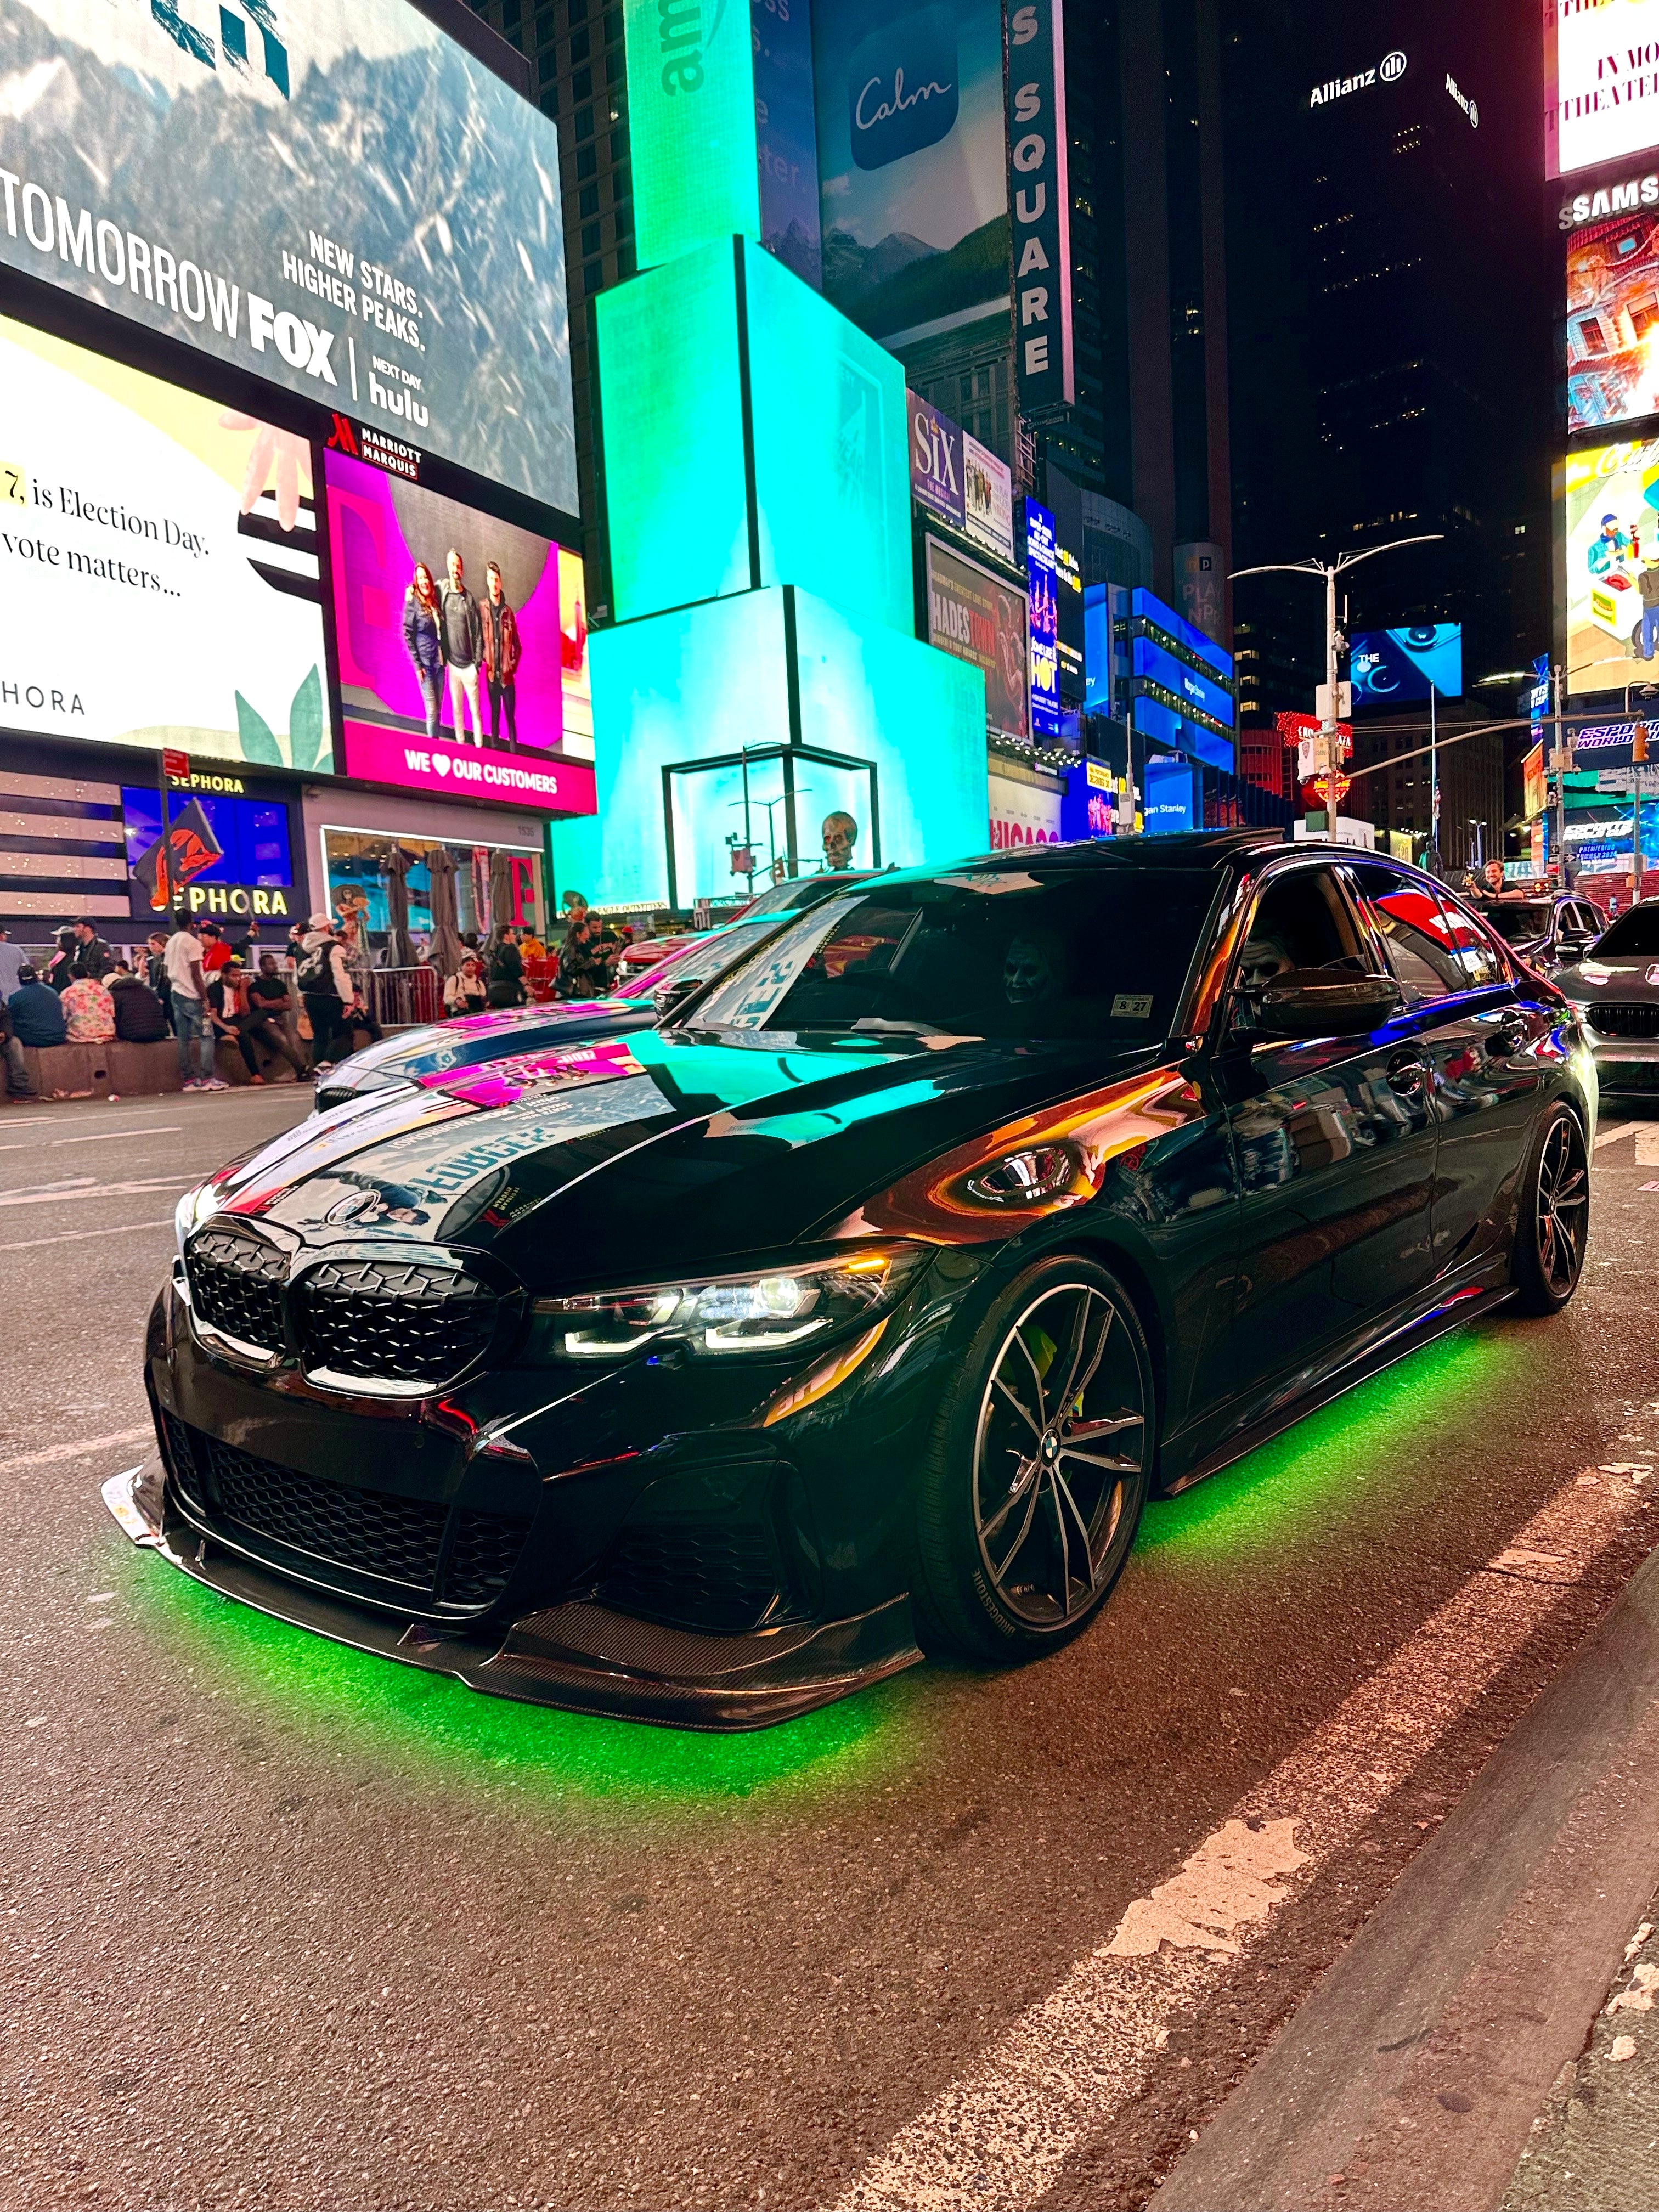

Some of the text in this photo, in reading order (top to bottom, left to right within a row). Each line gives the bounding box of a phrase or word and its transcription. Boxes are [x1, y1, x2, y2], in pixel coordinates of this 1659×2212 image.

[1310, 67, 1376, 108] Allianz
[1598, 54, 1619, 80] IN
[856, 67, 951, 130] Calm
[1445, 72, 1470, 116] Allianz
[1013, 83, 1051, 375] SQUARE
[0, 169, 338, 386] TOMORROW FOX
[309, 230, 423, 318] NEW STARS.
[282, 250, 425, 351] HIGHER PEAKS.
[373, 355, 421, 390] NEXT DAY
[369, 371, 428, 427] hulu
[362, 428, 421, 463] MARRIOTT
[363, 445, 416, 477] MARQUIS
[4, 470, 210, 558] 7, is Election Day.
[2, 532, 182, 598] vote matters...
[1031, 651, 1057, 695] HOT
[1358, 653, 1379, 663] THE
[1576, 735, 1635, 751] WORLD
[404, 749, 557, 794] WE OUR CUSTOMERS
[518, 826, 534, 837] 1535
[1160, 804, 1186, 815] Stanley
[622, 901, 668, 913] OUTFITTERS
[1119, 1001, 1147, 1011] 8 27
[971, 1567, 1017, 1638] BRIDGESTONE
